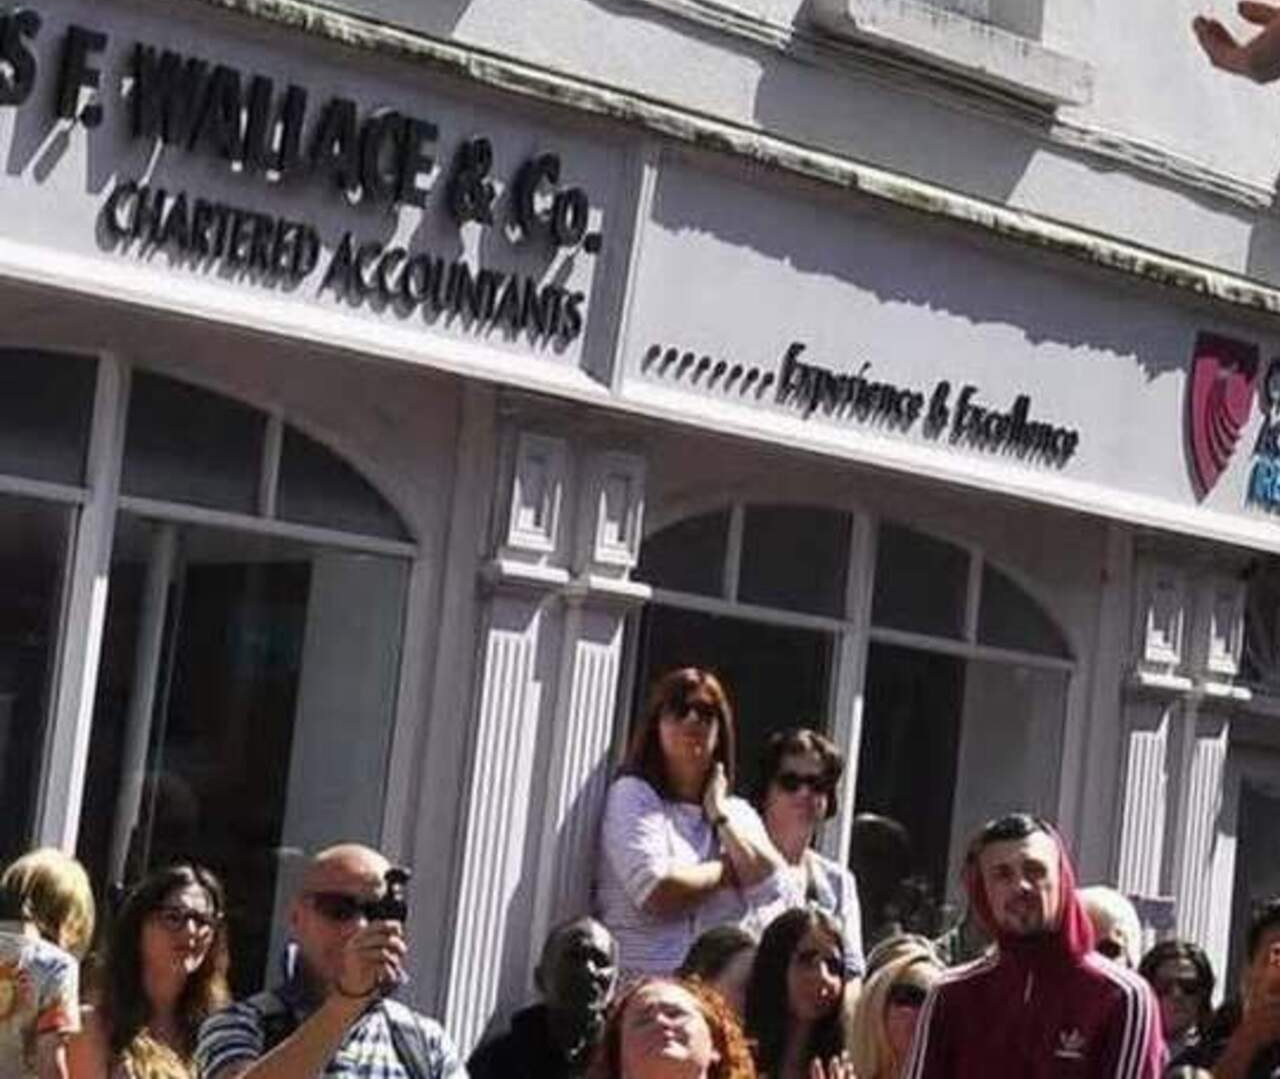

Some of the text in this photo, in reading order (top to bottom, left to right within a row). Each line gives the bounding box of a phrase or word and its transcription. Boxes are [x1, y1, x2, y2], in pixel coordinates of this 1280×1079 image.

[128, 40, 438, 210] WALLACE
[450, 135, 496, 226] &
[96, 180, 586, 350] CHARTERED ACCOUNTANTS
[774, 342, 1079, 470] Experience & Excellence
